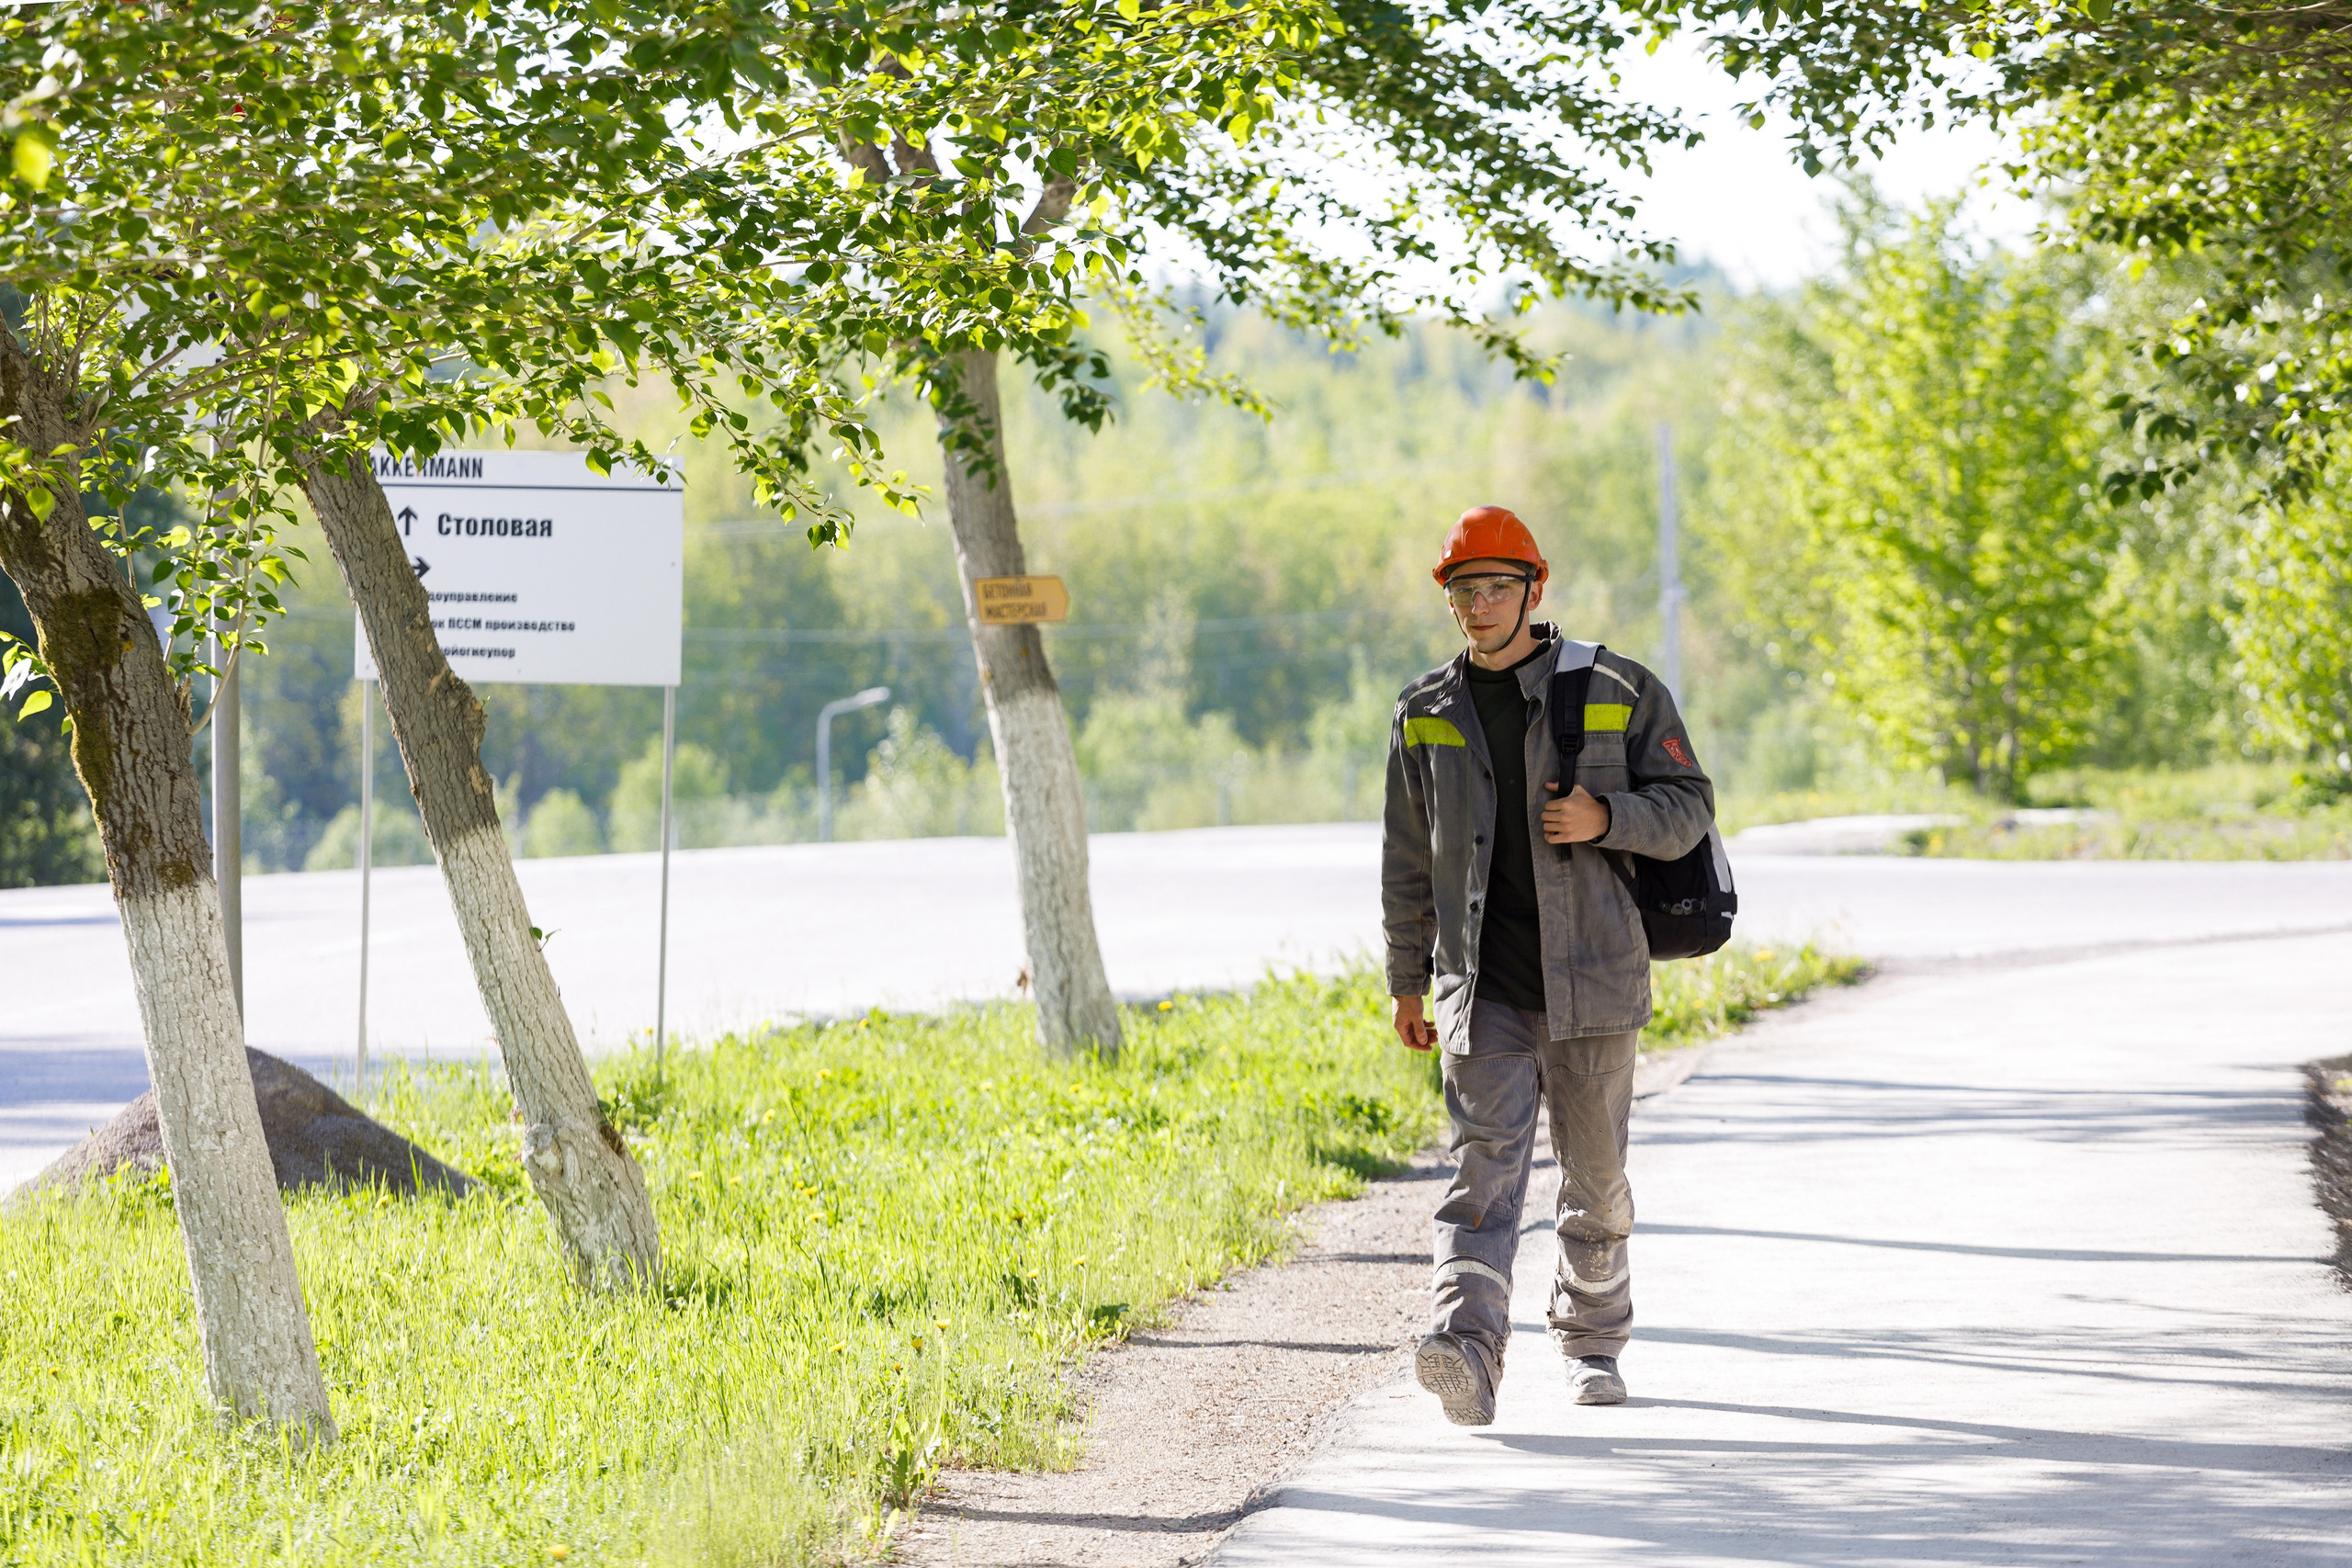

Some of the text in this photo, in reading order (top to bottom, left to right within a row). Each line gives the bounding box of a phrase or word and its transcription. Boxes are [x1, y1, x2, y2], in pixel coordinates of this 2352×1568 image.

[437, 513, 553, 537] Столовая
[428, 592, 518, 604] доуправление
[448, 617, 482, 629] ПССМ
[485, 619, 576, 632] производство
[443, 645, 516, 658] ойогнеупор
